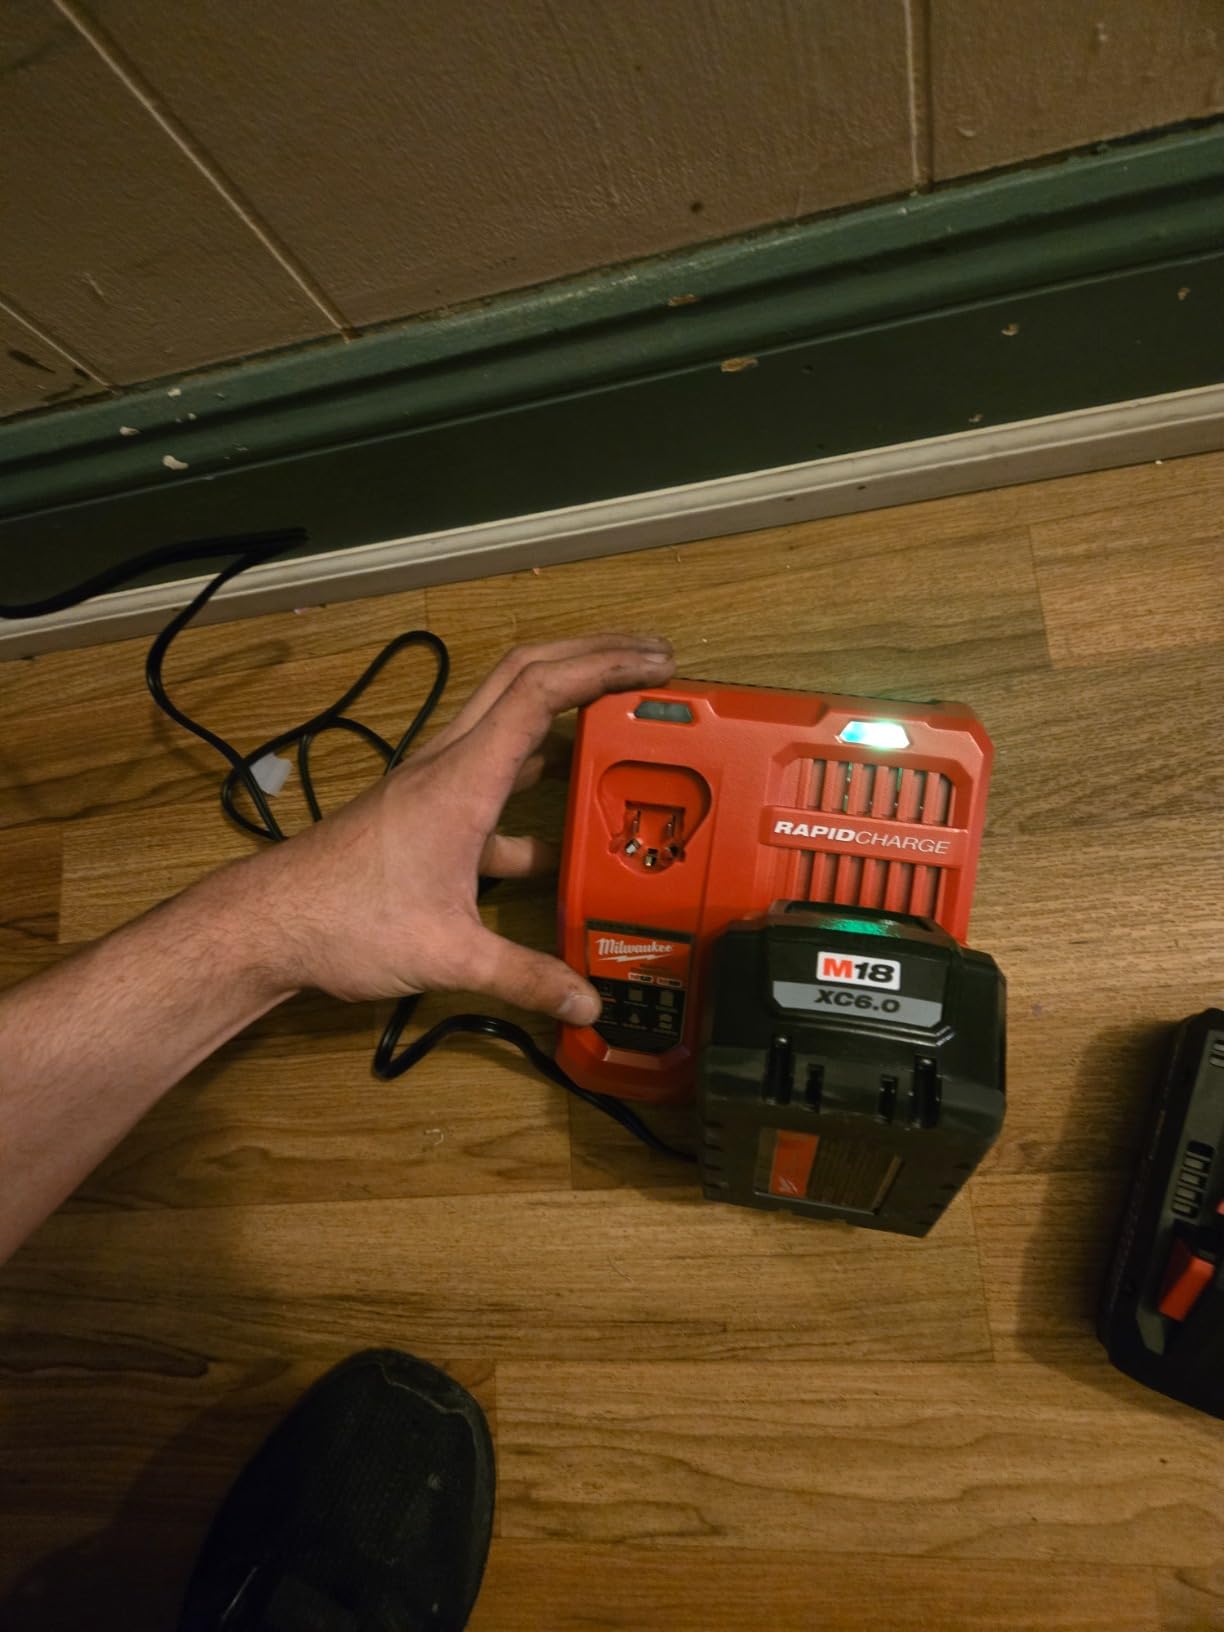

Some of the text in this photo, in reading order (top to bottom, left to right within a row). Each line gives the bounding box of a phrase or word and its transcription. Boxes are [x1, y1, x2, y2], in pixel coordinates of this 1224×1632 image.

[774, 821, 951, 855] RAPIDCHARGE
[594, 938, 673, 956] Milwaukee
[823, 957, 895, 983] M18
[815, 989, 900, 1013] XC6.0
